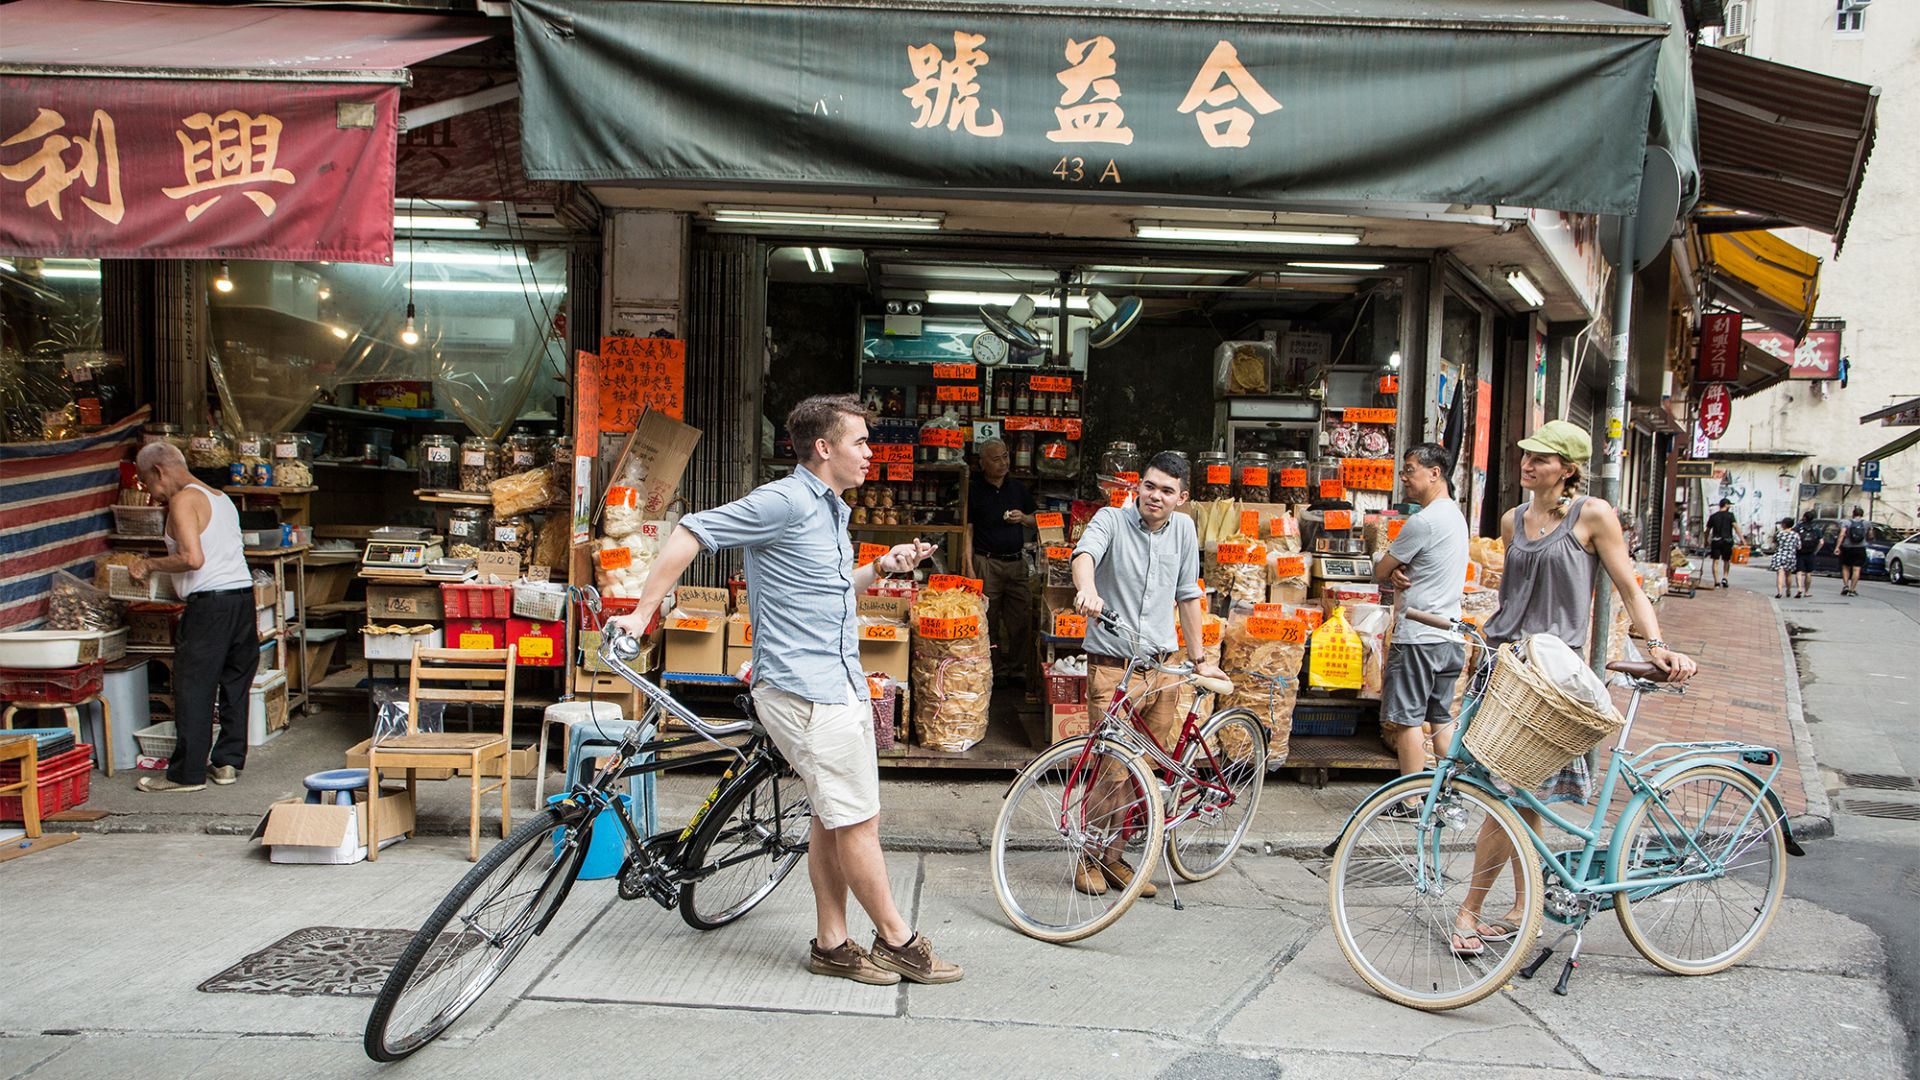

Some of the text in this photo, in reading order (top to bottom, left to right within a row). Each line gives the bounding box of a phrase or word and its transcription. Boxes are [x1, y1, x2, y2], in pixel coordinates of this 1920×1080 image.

[1052, 156, 1122, 184] 43 A
[1867, 463, 1878, 475] P
